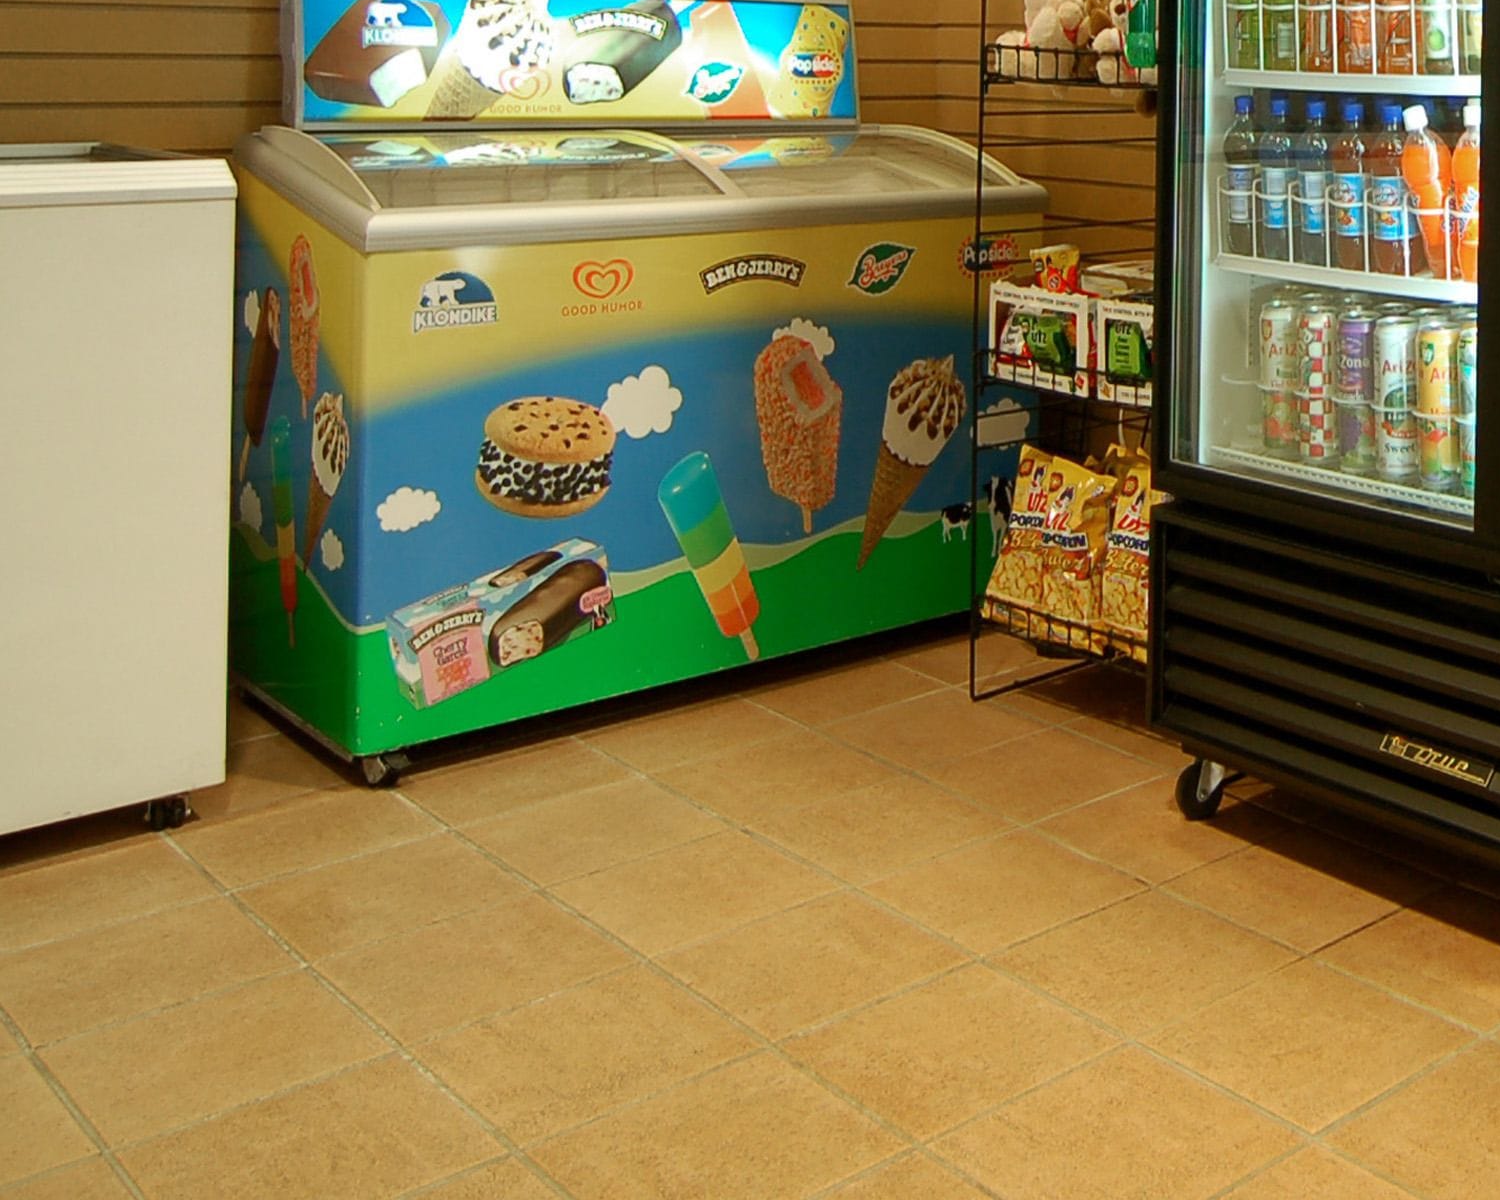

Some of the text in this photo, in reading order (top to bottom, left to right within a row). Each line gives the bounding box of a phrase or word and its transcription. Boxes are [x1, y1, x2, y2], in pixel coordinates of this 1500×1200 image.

[705, 259, 733, 290] BEN
[748, 256, 800, 284] JERRY'S
[413, 304, 498, 331] KLONDIKE
[561, 300, 644, 318] GOOD HUMOR
[413, 628, 434, 649] BEN
[443, 611, 483, 632] JERRY'S
